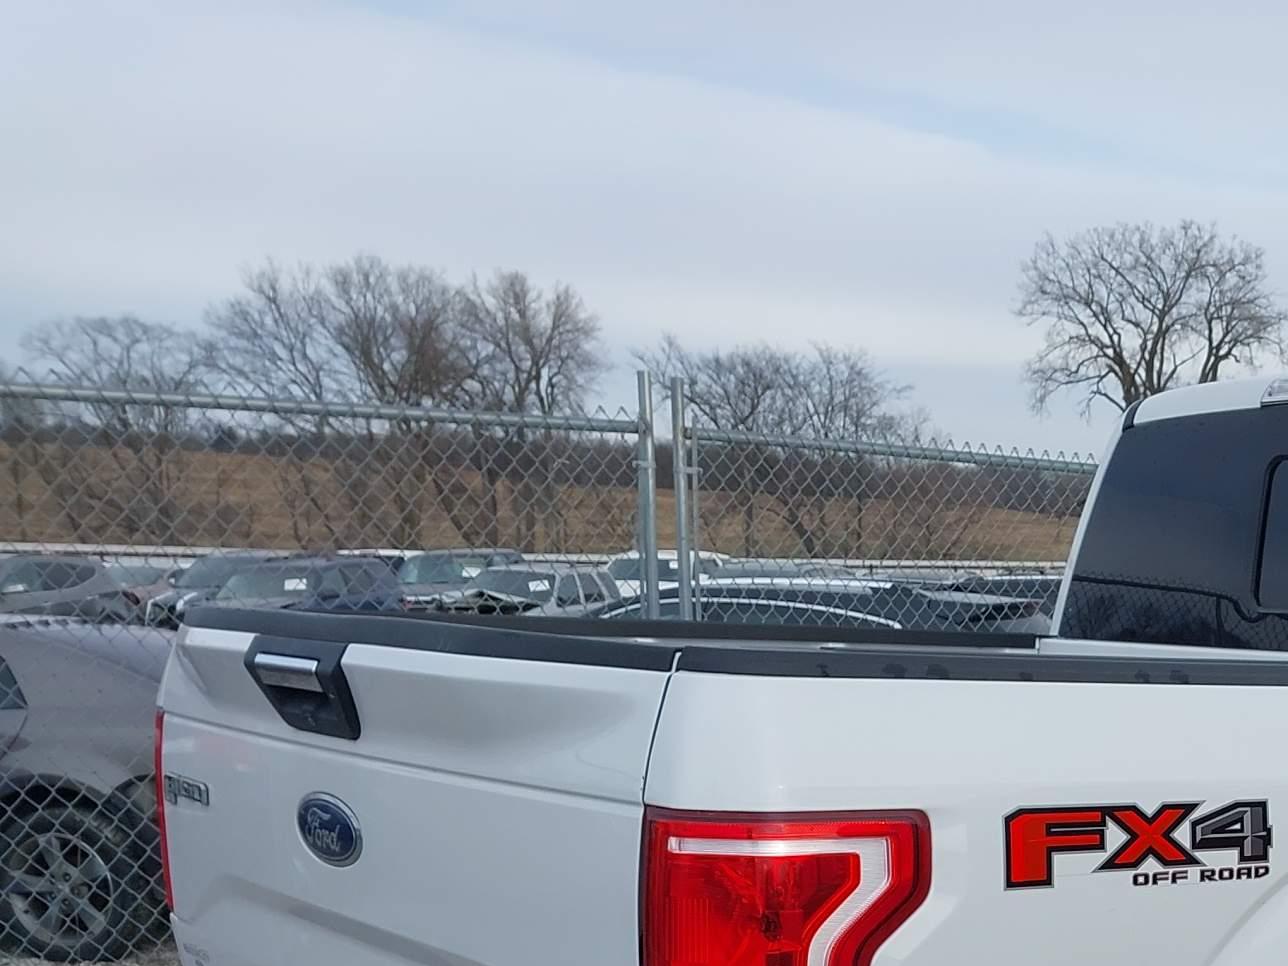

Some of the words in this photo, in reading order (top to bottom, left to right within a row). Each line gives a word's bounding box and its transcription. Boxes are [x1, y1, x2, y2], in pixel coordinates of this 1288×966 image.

[1002, 798, 1273, 891] FX4
[1132, 870, 1189, 887] OFF
[1199, 865, 1271, 883] ROAD
